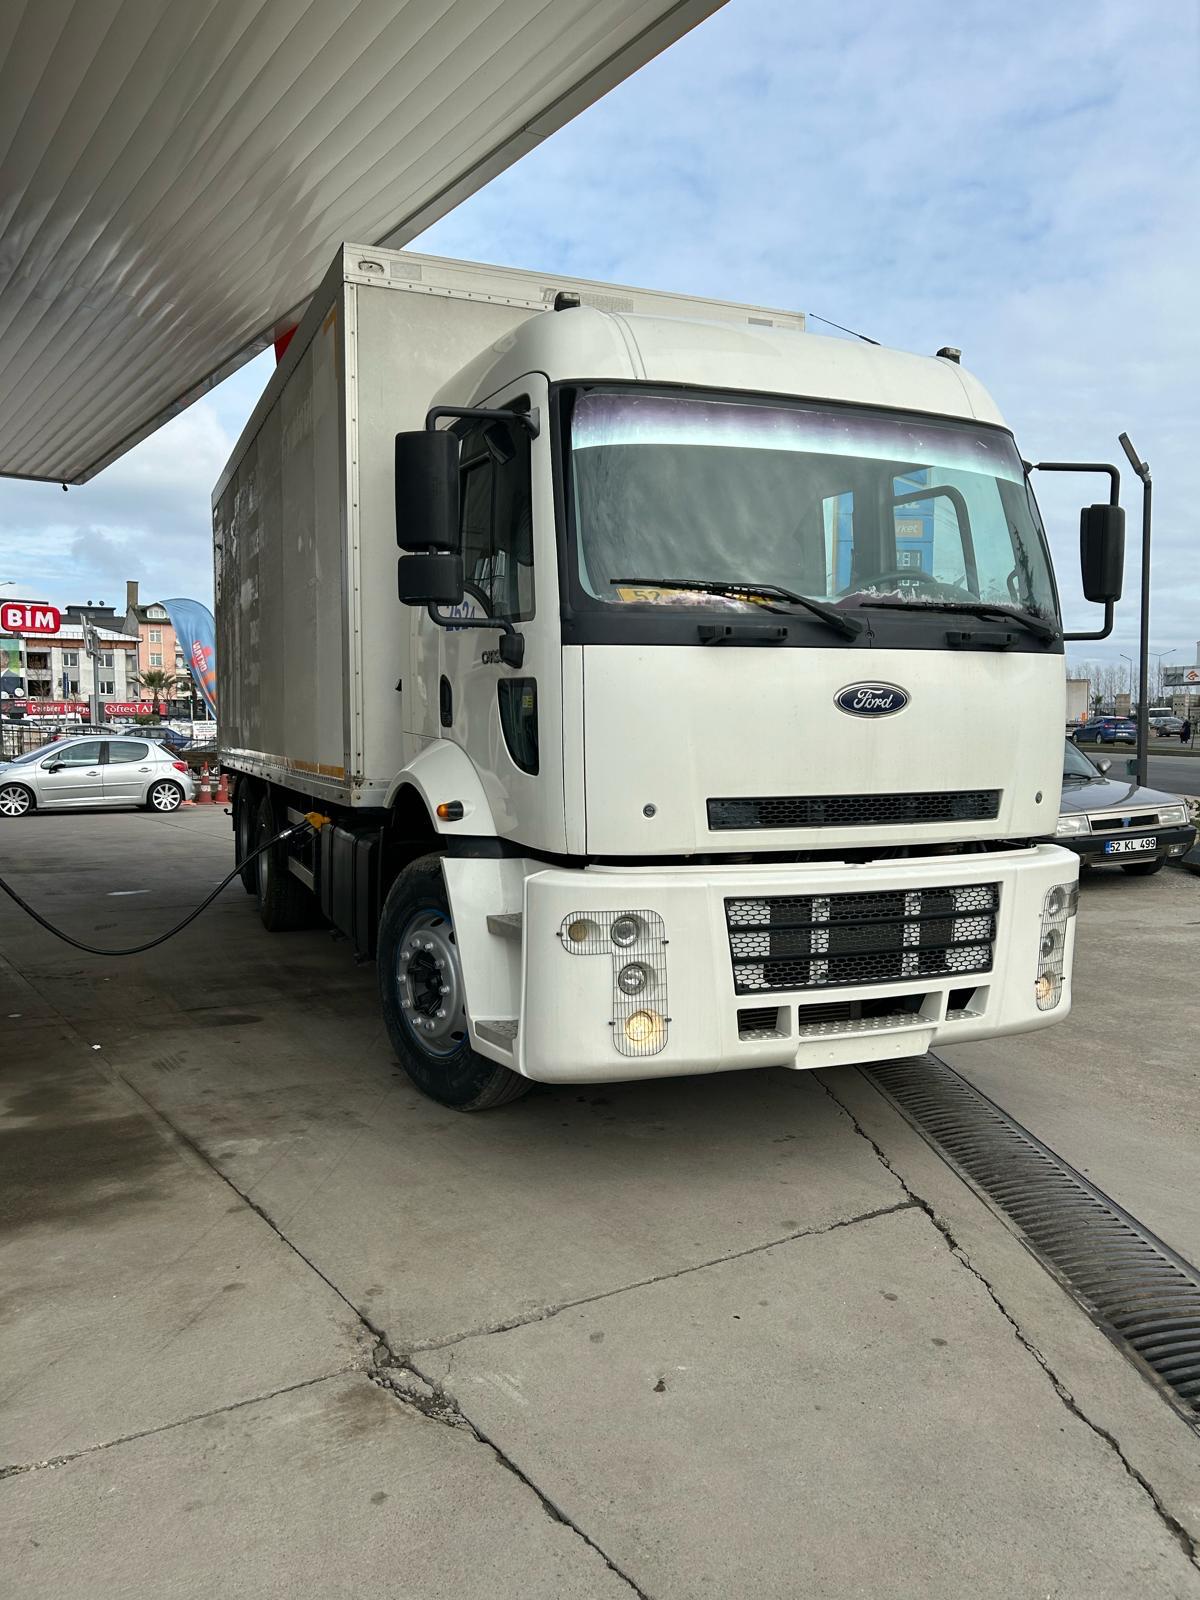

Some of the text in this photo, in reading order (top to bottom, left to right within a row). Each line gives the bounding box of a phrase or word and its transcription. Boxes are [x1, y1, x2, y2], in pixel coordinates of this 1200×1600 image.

[854, 689, 894, 708] Ford
[1110, 839, 1156, 852] 52 KL 499
